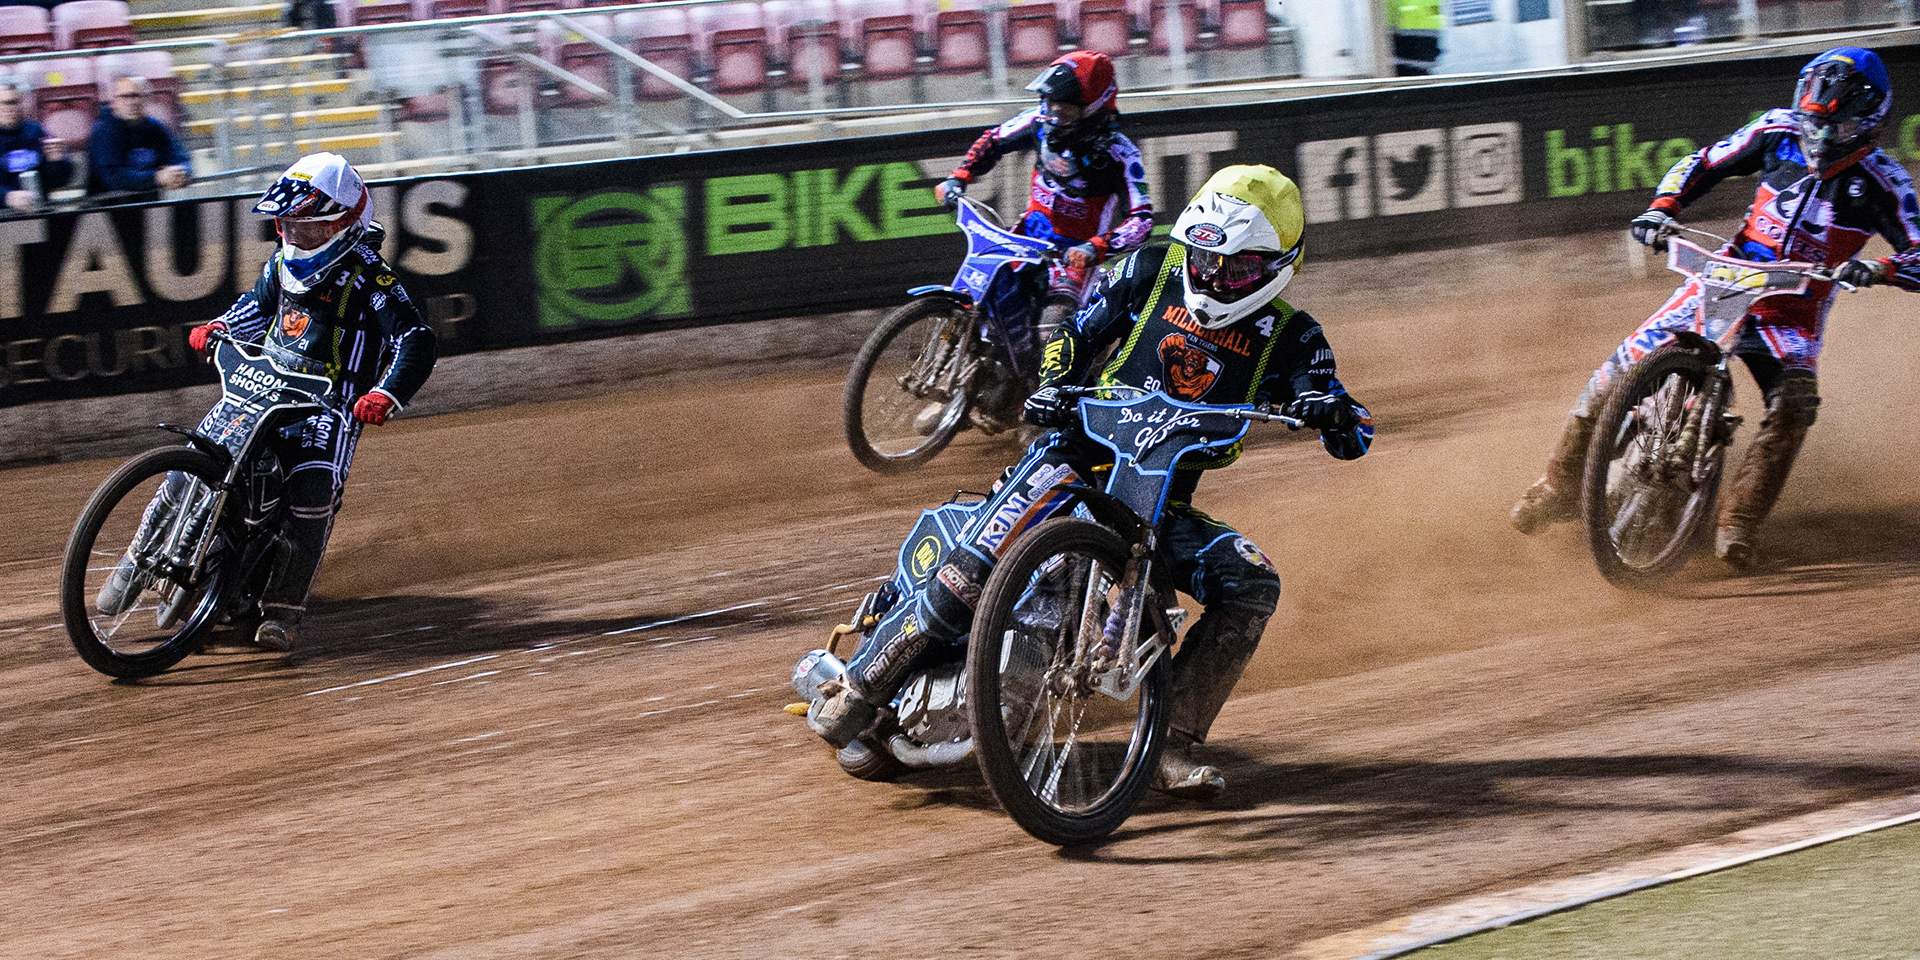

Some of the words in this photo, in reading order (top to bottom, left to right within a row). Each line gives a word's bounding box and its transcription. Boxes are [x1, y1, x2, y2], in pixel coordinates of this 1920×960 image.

[1192, 228, 1220, 240] STS
[0, 176, 478, 322] TAUS
[335, 271, 350, 287] 3
[1255, 315, 1275, 338] 4
[298, 338, 310, 351] 21
[1187, 334, 1199, 343] FEN
[1199, 339, 1218, 352] TIGERS
[234, 362, 288, 391] HAGON
[1143, 375, 1161, 391] 20
[228, 373, 281, 403] SHOCKS
[1117, 407, 1143, 424] Do
[1147, 408, 1168, 424] it
[313, 411, 336, 451] AGON
[1030, 466, 1071, 499] SWEEPERS
[1031, 466, 1051, 483] ROAD
[981, 495, 1029, 549] KJM
